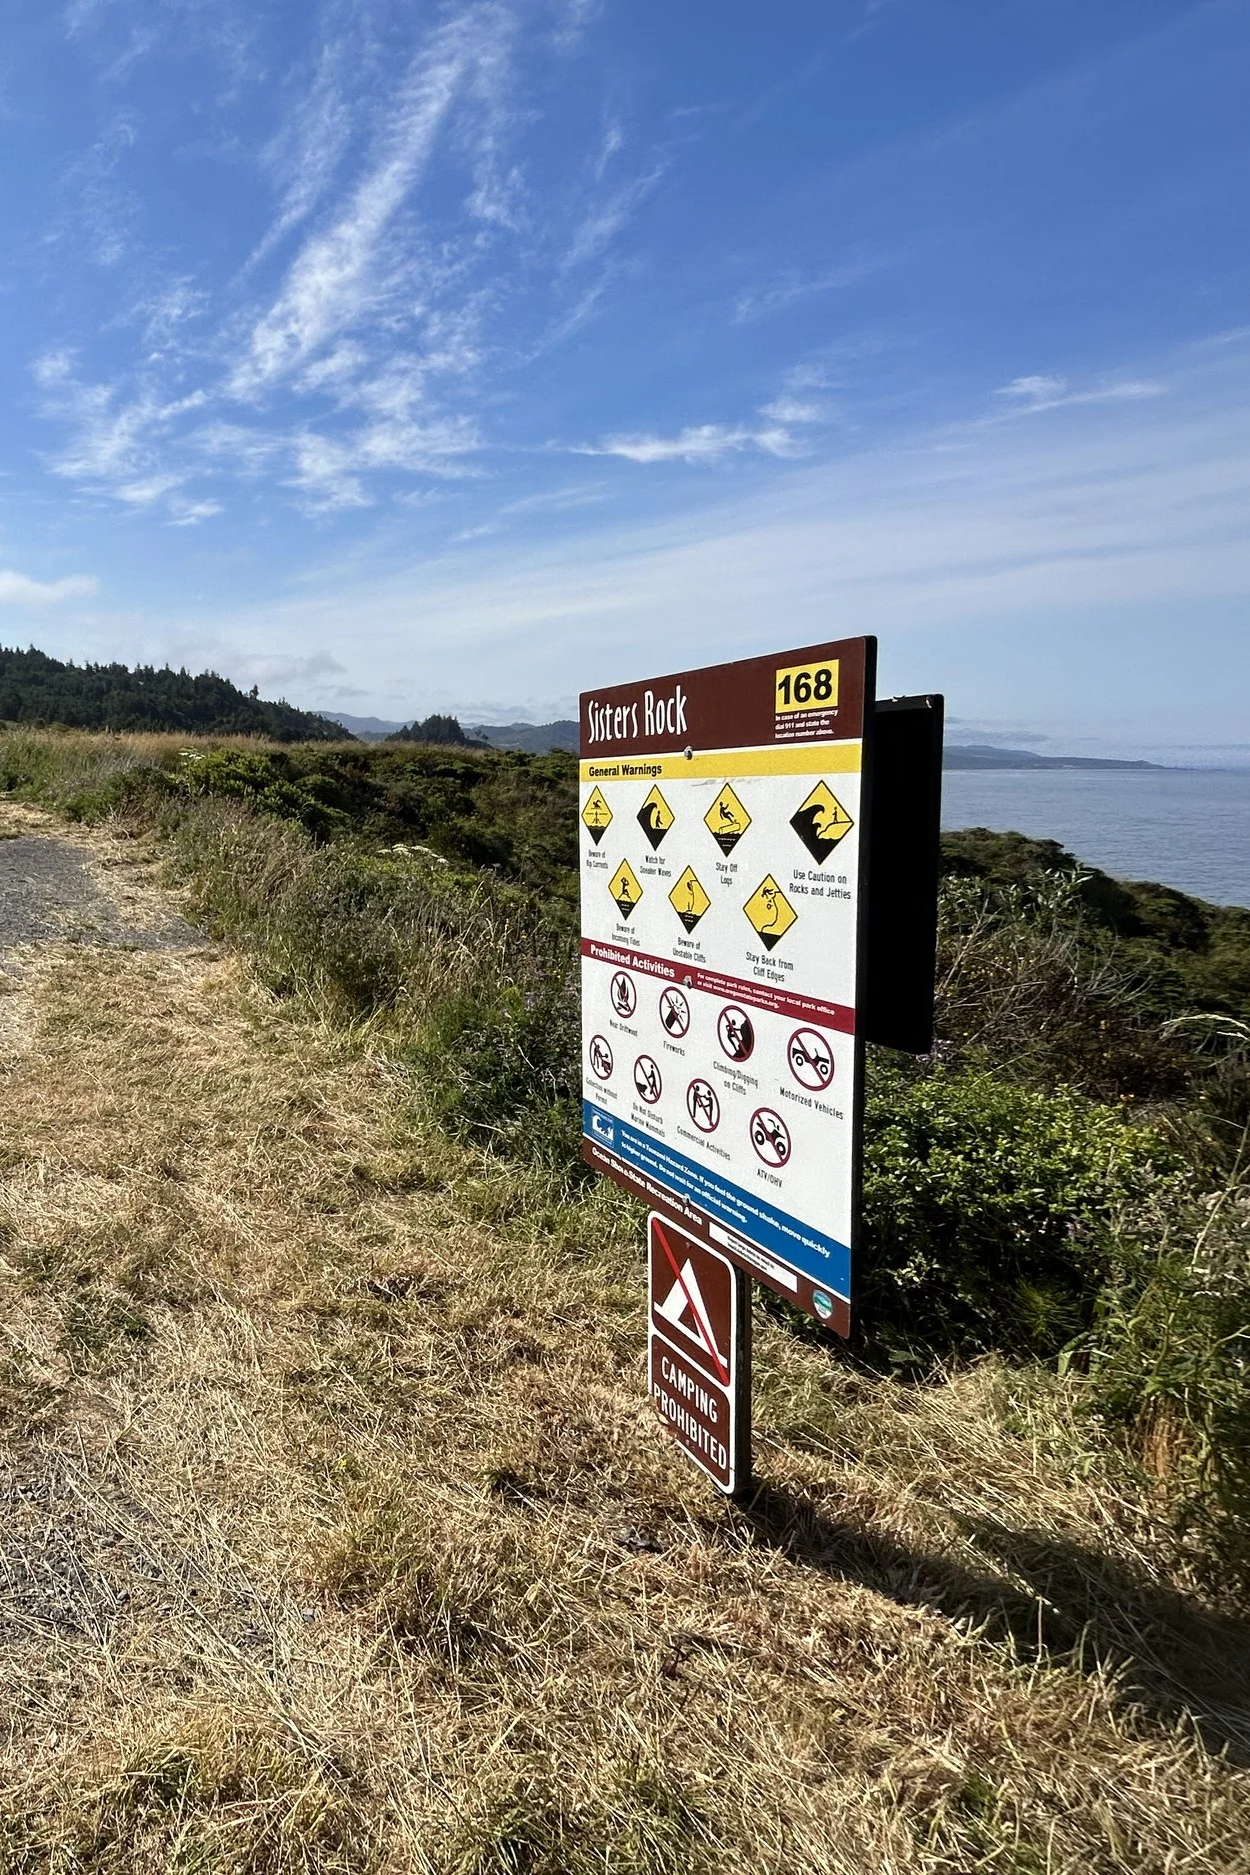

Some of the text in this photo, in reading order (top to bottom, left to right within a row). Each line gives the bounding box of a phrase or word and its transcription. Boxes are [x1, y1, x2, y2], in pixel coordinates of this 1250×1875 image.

[778, 668, 832, 705] 168
[588, 685, 687, 744] Sisters Rock
[807, 709, 838, 718] emergency
[588, 763, 662, 777] General Warnings
[588, 849, 601, 858] Beware
[645, 855, 666, 865] Watch for
[592, 860, 609, 869] Currents
[639, 865, 671, 877] Sneaker Waves
[715, 862, 738, 873] Stay Off
[720, 875, 733, 887] Logs
[793, 869, 847, 884] Use Caution on
[789, 882, 851, 900] Rocks and Jetties
[616, 923, 635, 935] Beware of
[611, 932, 640, 947] Incoming Tides
[677, 936, 701, 950] Beware of
[590, 944, 675, 978] Prohibited Activities
[672, 947, 706, 963] Unstable Cliffs
[745, 951, 794, 971] Stay Back from
[753, 966, 785, 983] Cliff Edges
[705, 975, 726, 985] complete
[738, 985, 752, 993] rules,
[752, 989, 773, 999] contact
[773, 994, 786, 1002] your
[786, 997, 801, 1006] local
[801, 1002, 816, 1010] park
[816, 1005, 835, 1015] office
[663, 1040, 685, 1056] Fireworks
[713, 1060, 758, 1089] Climbing/Digging
[723, 1080, 746, 1096] on Cliffs
[779, 1086, 844, 1120] Motorized Vehicles
[645, 1120, 665, 1138] Mammals
[676, 1125, 731, 1161] Commercial Activities
[592, 1146, 610, 1165] Ocean
[646, 1181, 683, 1213] Recreation
[683, 1206, 702, 1225] Area
[756, 1168, 782, 1188] ATV/OHV
[621, 1129, 630, 1140] You
[645, 1143, 666, 1161] Tsunami
[665, 1156, 684, 1172] Hazard
[704, 1179, 715, 1189] you
[714, 1184, 726, 1196] feel
[725, 1191, 736, 1202] the
[736, 1199, 759, 1216] ground
[759, 1212, 781, 1230] shake,
[781, 1225, 801, 1241] move
[801, 1236, 830, 1258] quickly
[700, 1190, 721, 1207] official
[661, 1356, 717, 1423] CAMPING
[653, 1382, 727, 1470] PROHIBITED
